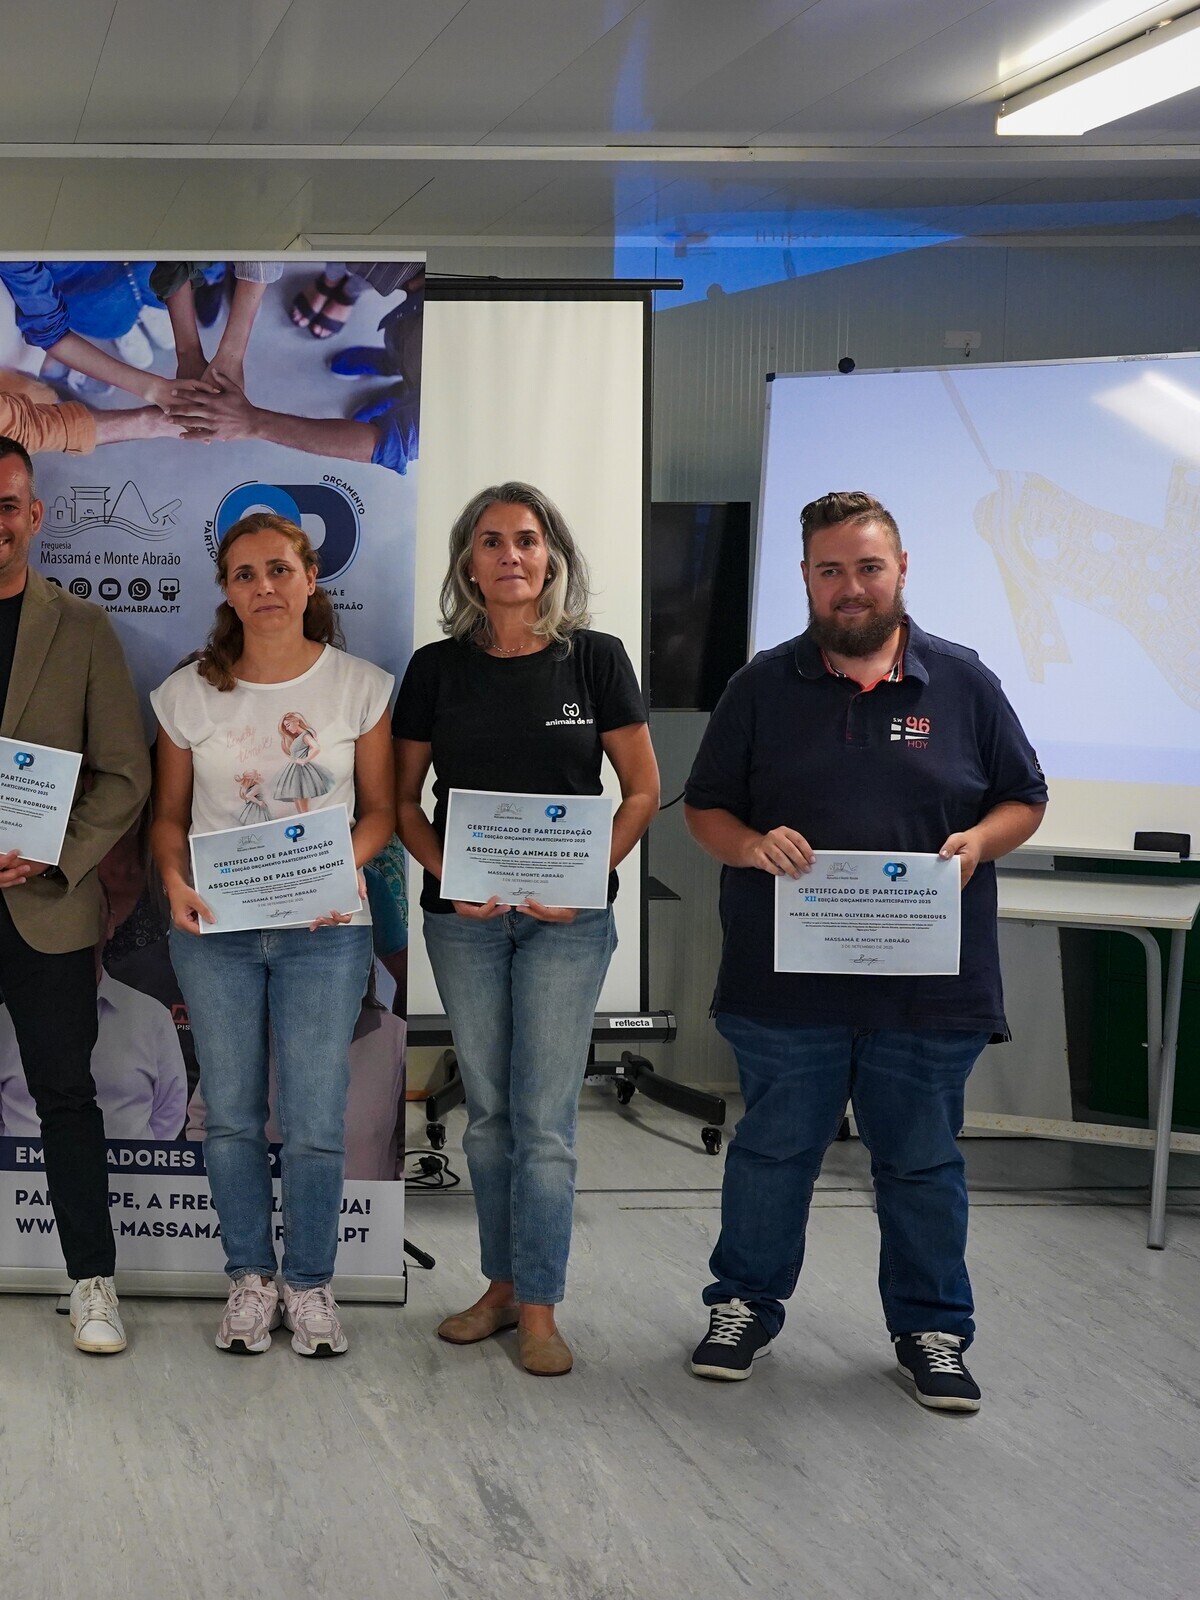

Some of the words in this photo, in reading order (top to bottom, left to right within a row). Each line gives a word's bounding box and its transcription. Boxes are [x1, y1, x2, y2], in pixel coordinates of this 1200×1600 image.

[322, 474, 365, 515] ORÇAMENTO
[41, 541, 71, 551] Freguesia
[40, 551, 91, 564] Massamá
[94, 555, 100, 564] e
[103, 552, 139, 565] Monte
[142, 552, 181, 565] Abraão
[545, 718, 576, 726] animais
[905, 716, 930, 733] 96
[1, 773, 55, 789] PARTICIPAÇÃO
[1, 782, 37, 793] PARTICIPATIVO
[468, 824, 519, 833] CERTIFICADO
[214, 856, 264, 868] CERTIFICADO
[278, 841, 333, 857] PARTICIPAÇÃO
[251, 861, 281, 869] ORÇAMENTO
[282, 853, 317, 864] PARTICIPATIVO
[873, 888, 937, 897] PARTICIPAÇÃO
[615, 1019, 650, 1027] reflecta
[15, 1146, 196, 1167] EMADORES
[147, 1193, 162, 1209] A
